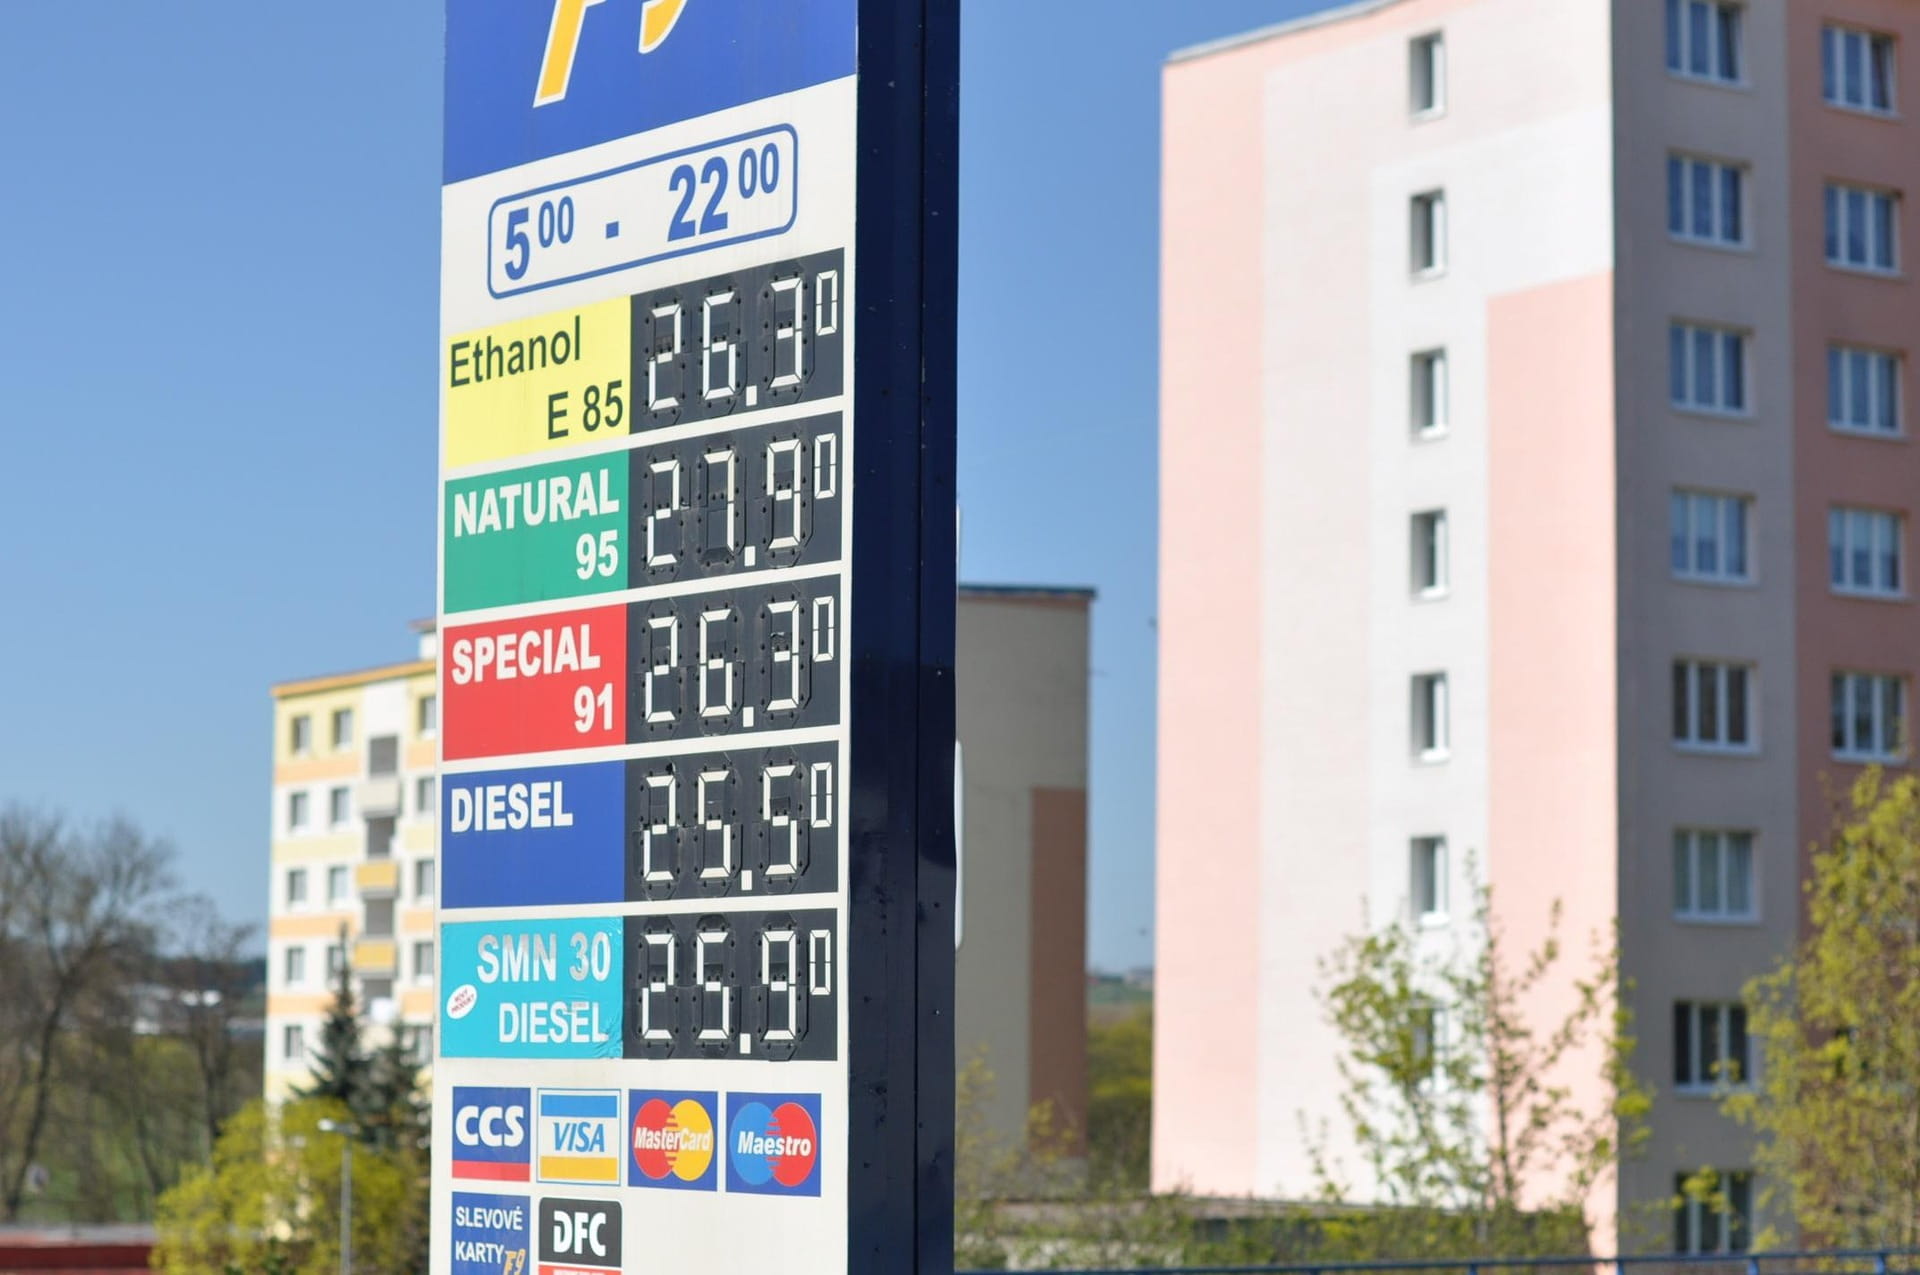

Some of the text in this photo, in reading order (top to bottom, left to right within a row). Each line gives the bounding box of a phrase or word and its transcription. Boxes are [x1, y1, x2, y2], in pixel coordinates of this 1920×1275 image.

[450, 315, 581, 388] Ethanol
[548, 379, 624, 440] E 85
[453, 468, 620, 538] NATURAL
[576, 528, 619, 580] 95
[451, 623, 601, 685] SPECIAL
[573, 682, 614, 733] 91
[450, 780, 574, 833] DIESEL
[476, 931, 612, 984] SMN 30
[499, 1001, 610, 1044] DIESEL
[455, 1105, 525, 1148] CCS
[553, 1121, 606, 1153] VISA
[634, 1126, 713, 1153] MasterCard
[737, 1130, 812, 1157] Maestro
[455, 1205, 524, 1231] SLEVOVÉ
[553, 1210, 607, 1257] DFC
[455, 1240, 504, 1265] KARTY
